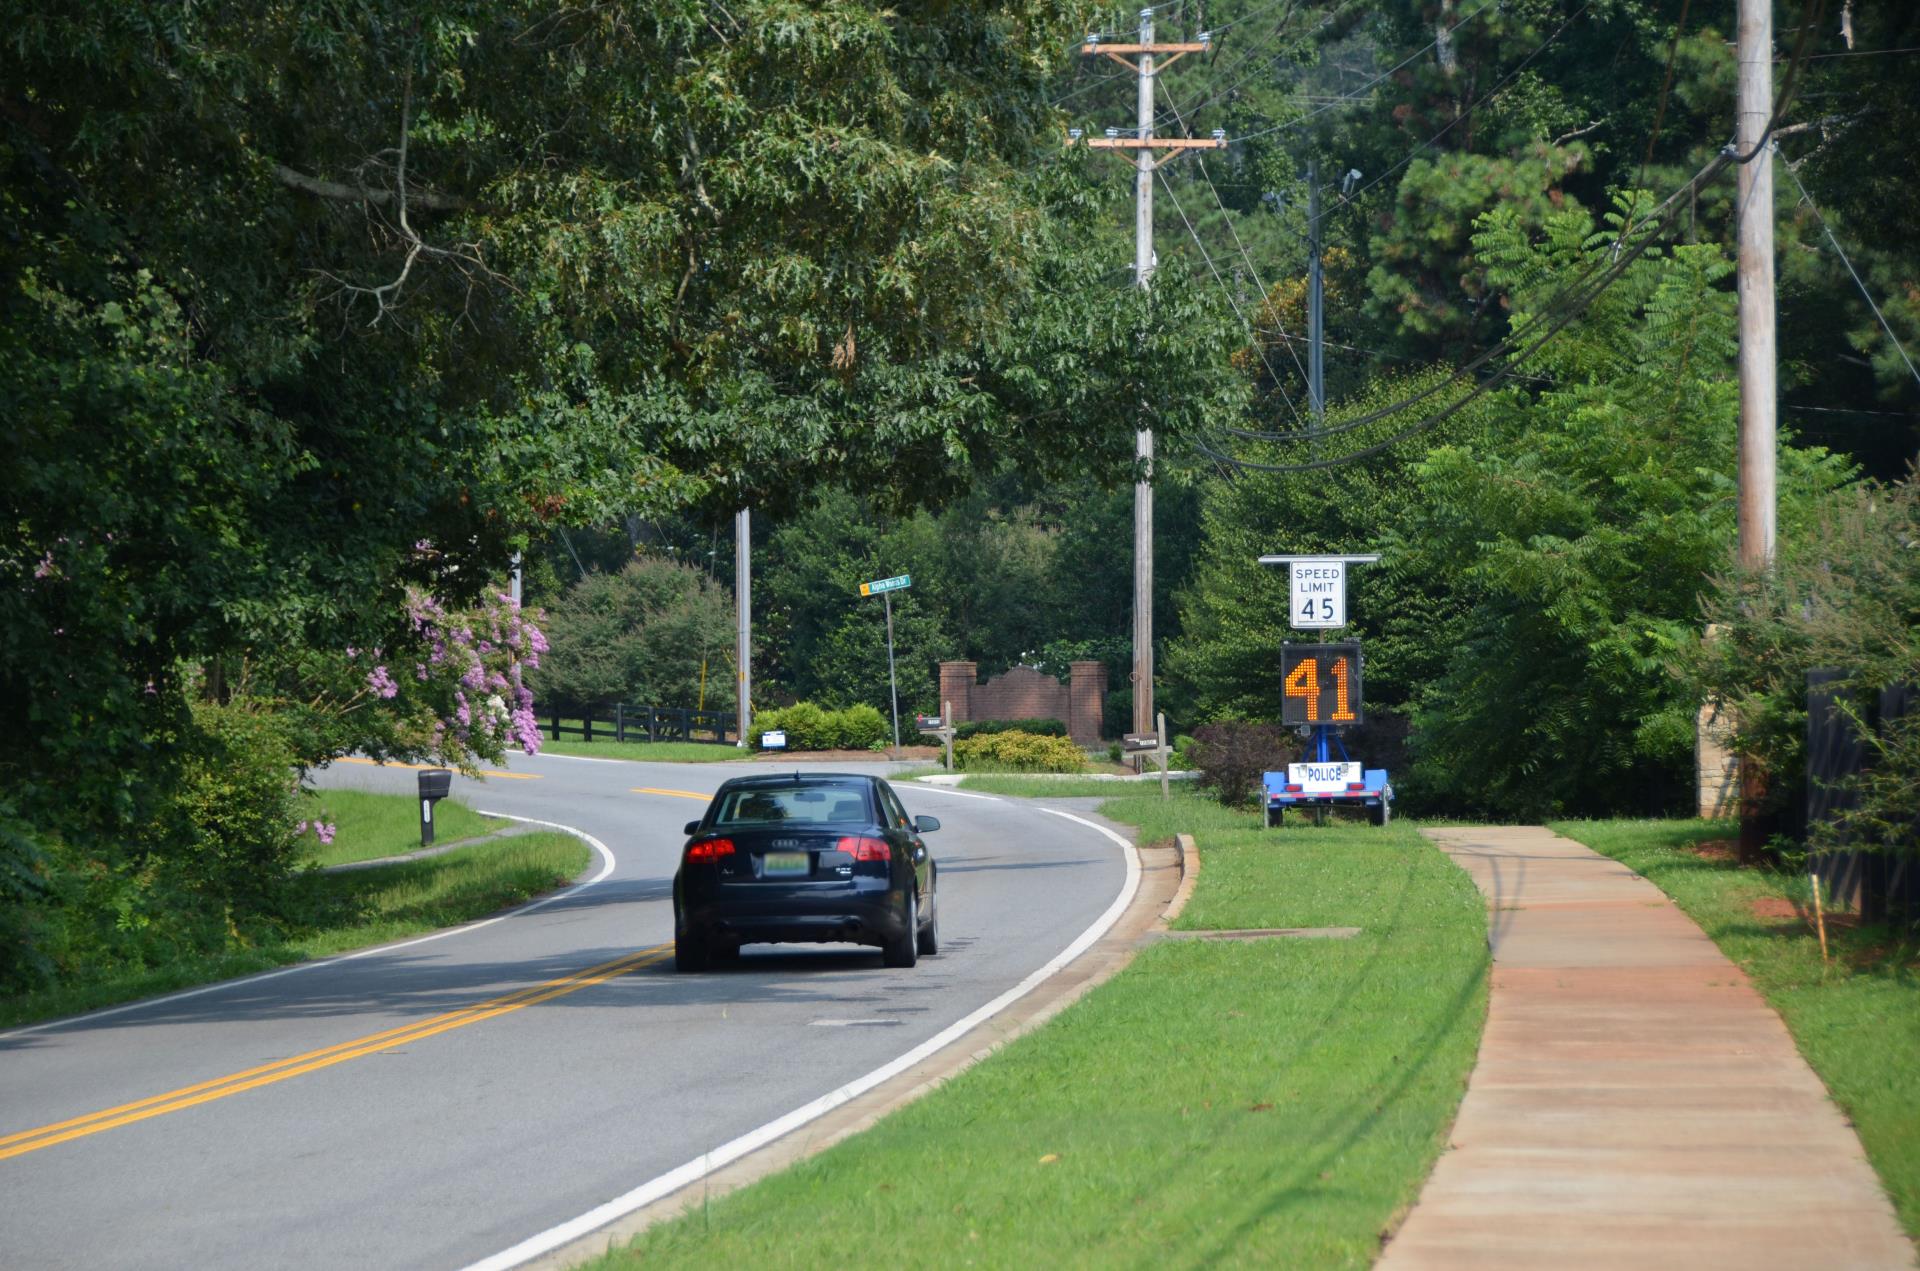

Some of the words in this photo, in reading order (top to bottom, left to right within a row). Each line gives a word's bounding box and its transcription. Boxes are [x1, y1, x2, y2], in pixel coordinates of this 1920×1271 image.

[1296, 569, 1339, 579] SPEED
[1300, 582, 1334, 592] LIMIT
[1301, 598, 1334, 619] 45
[1285, 657, 1356, 720] 41
[1308, 767, 1341, 782] POLICE
